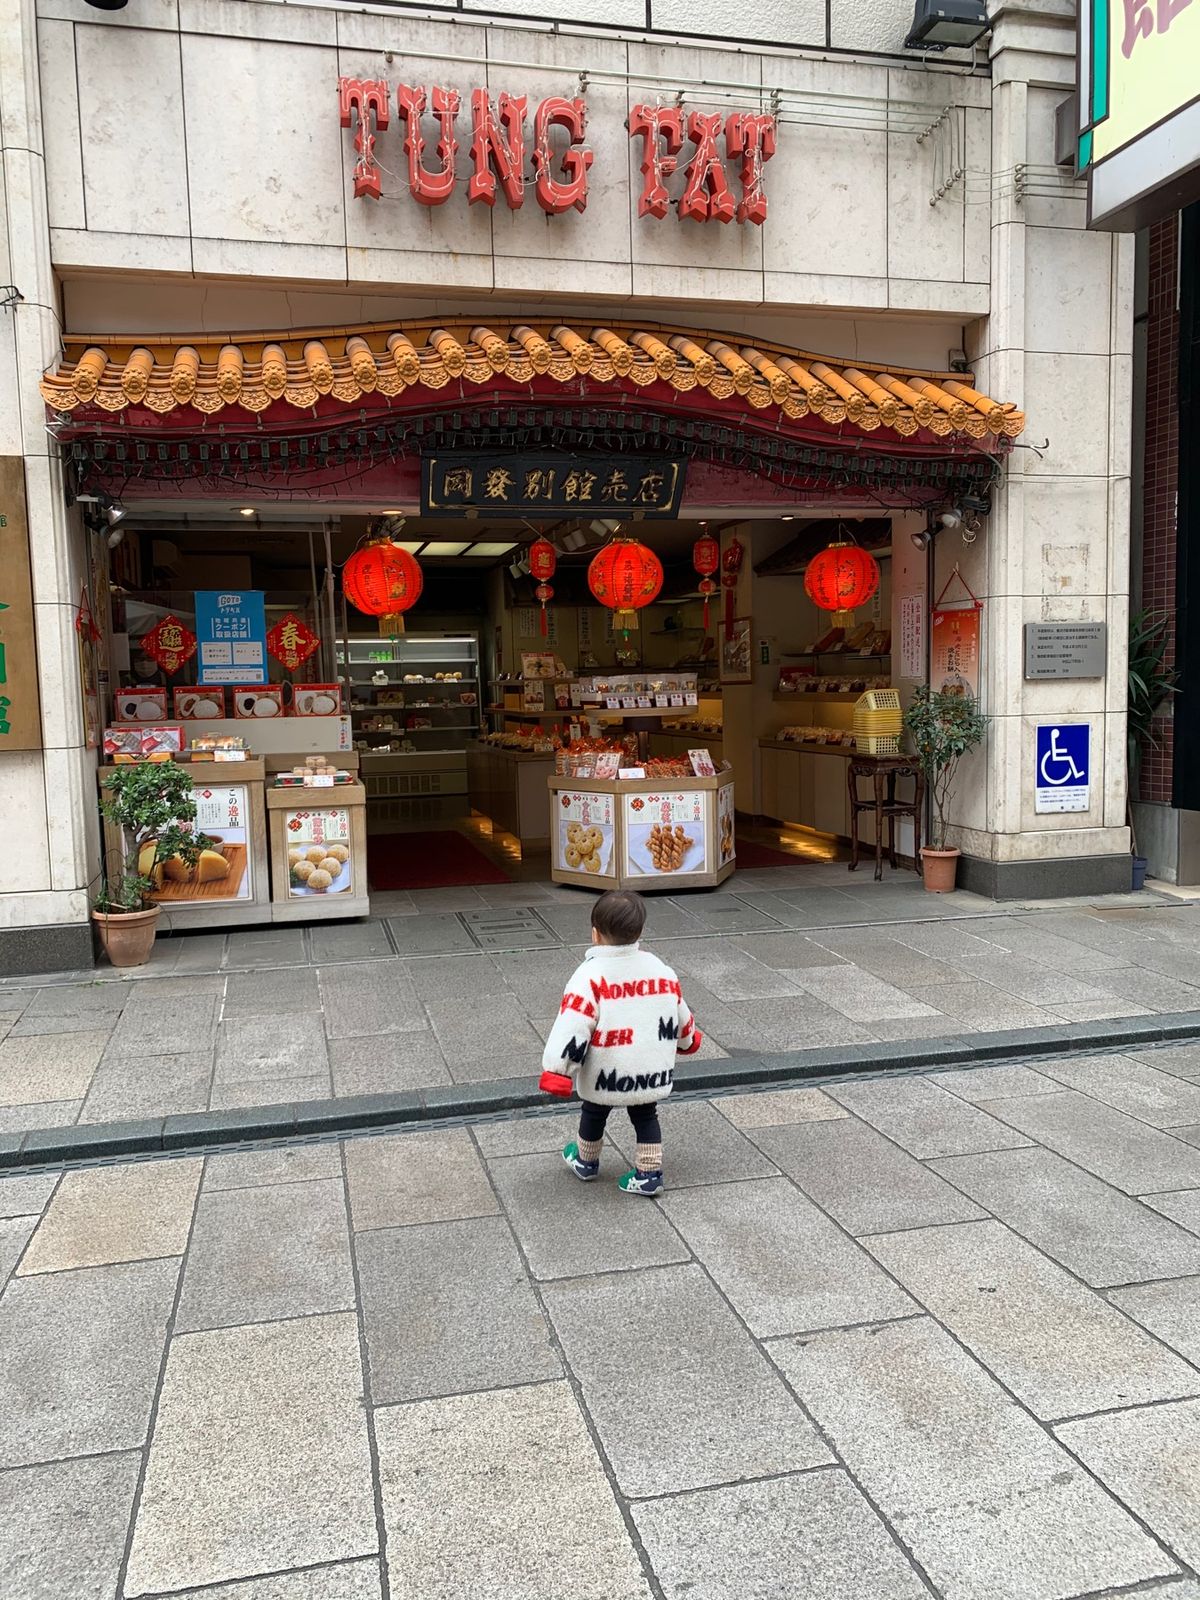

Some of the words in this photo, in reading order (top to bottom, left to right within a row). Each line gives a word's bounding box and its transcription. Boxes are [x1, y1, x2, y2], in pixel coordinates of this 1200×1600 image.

[338, 77, 593, 215] TUNG
[628, 103, 778, 226] FAT
[278, 621, 306, 650] 春
[228, 788, 239, 827] この逸品
